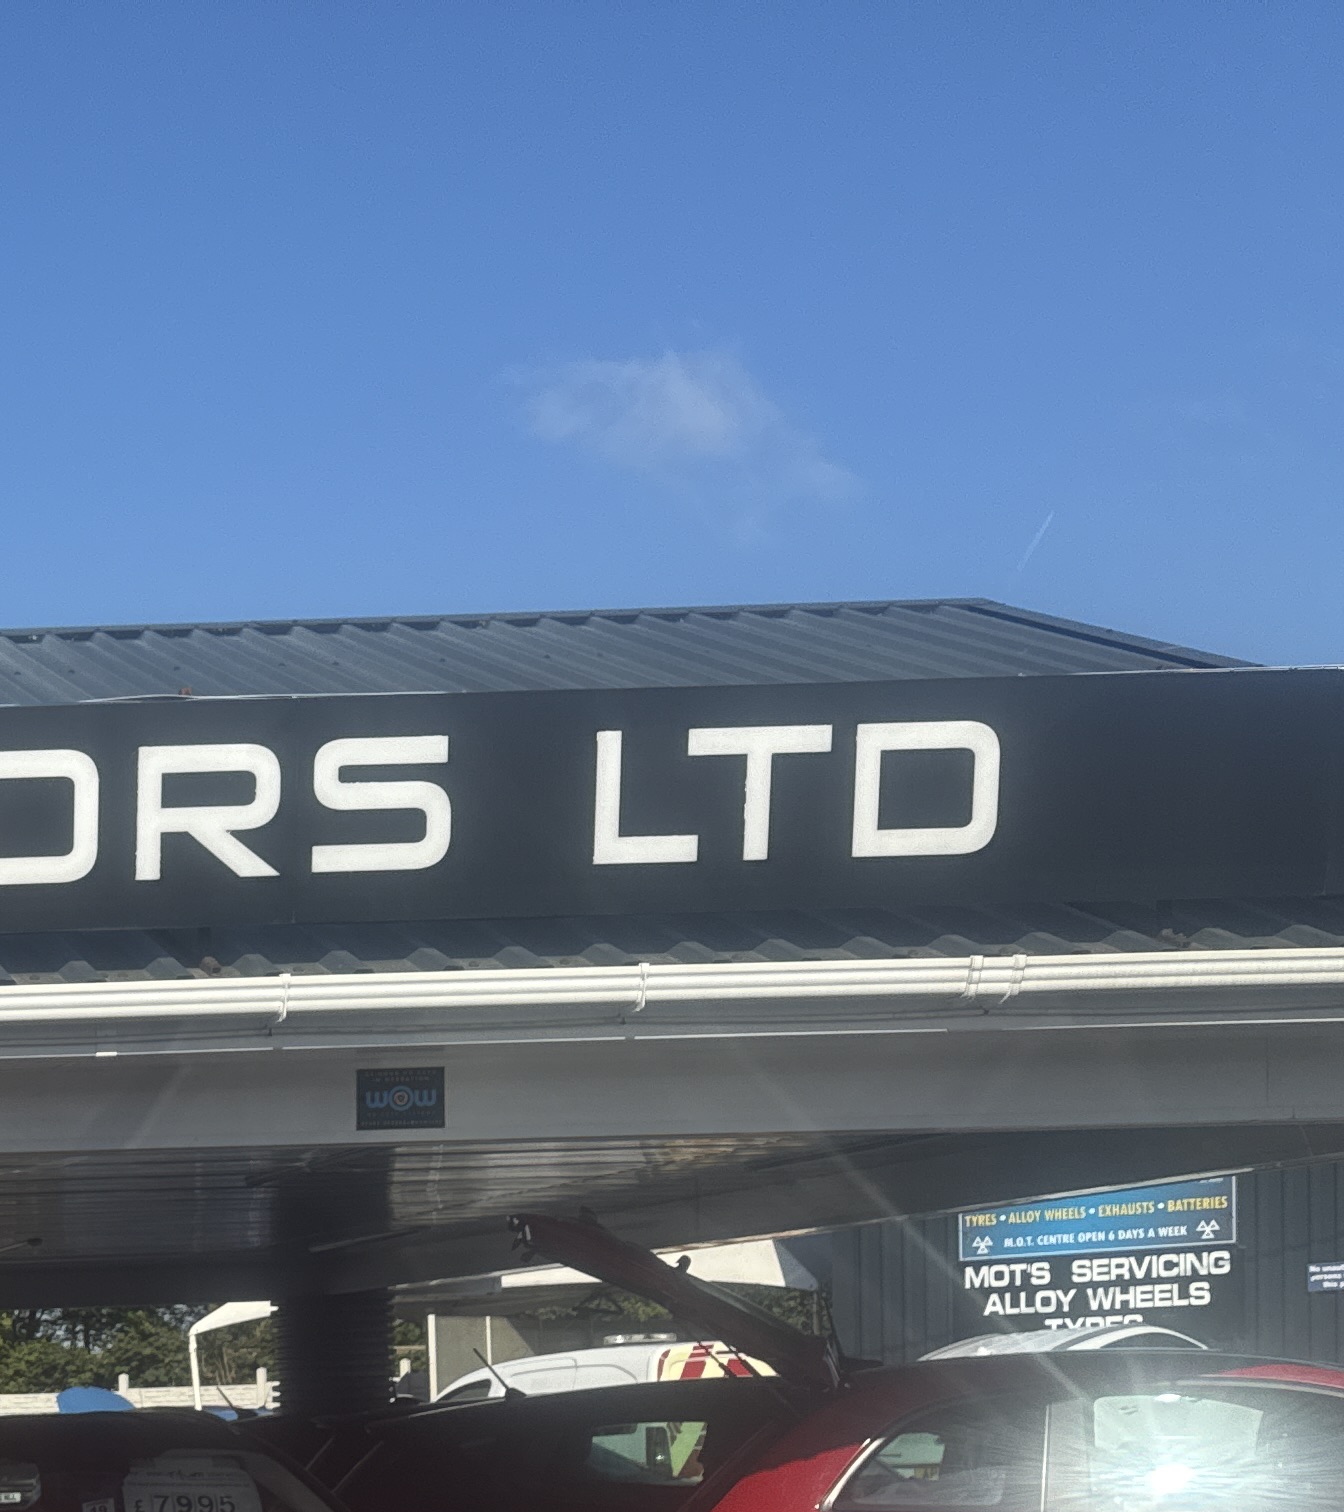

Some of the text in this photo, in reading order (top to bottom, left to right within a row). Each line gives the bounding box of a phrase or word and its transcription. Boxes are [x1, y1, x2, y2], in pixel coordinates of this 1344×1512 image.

[592, 720, 1001, 865] LTD
[964, 1195, 1229, 1228] TYRES ALLOY WHEELS EXHAUSTS BATTERIES
[1037, 1233, 1075, 1246] CENTRE
[1077, 1230, 1106, 1243] OPEN
[1108, 1230, 1115, 1242] 6
[1118, 1227, 1145, 1240] DAYS
[1147, 1227, 1156, 1239] A
[1157, 1225, 1189, 1238] WEEK
[964, 1250, 1231, 1290] MOT'S SERVICING
[983, 1281, 1212, 1317] ALLOY WHEELS
